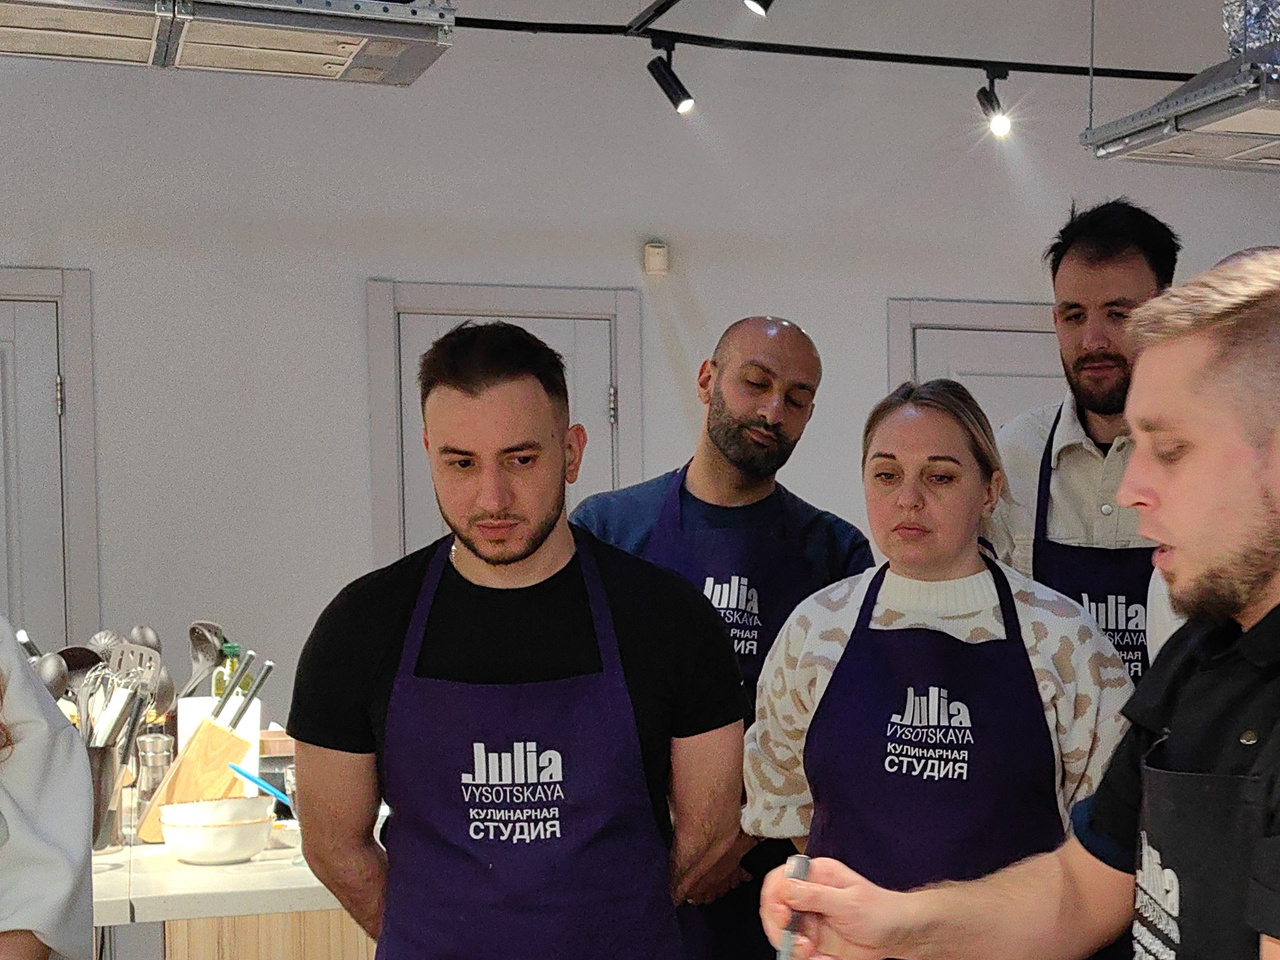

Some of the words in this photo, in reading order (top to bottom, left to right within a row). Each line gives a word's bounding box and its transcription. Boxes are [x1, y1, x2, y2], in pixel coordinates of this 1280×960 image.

[717, 609, 762, 627] TSKAYA
[890, 686, 972, 727] Julia
[886, 723, 975, 744] VYSOTSKAYA
[887, 742, 968, 761] КУЛИНАРНАЯ
[461, 741, 563, 784] Julia
[884, 755, 968, 781] СТУДИЯ
[461, 784, 565, 803] VYSOTSKAYA
[469, 807, 559, 821] КУЛИНАРНАЯ
[469, 820, 561, 844] СТУДИЯ
